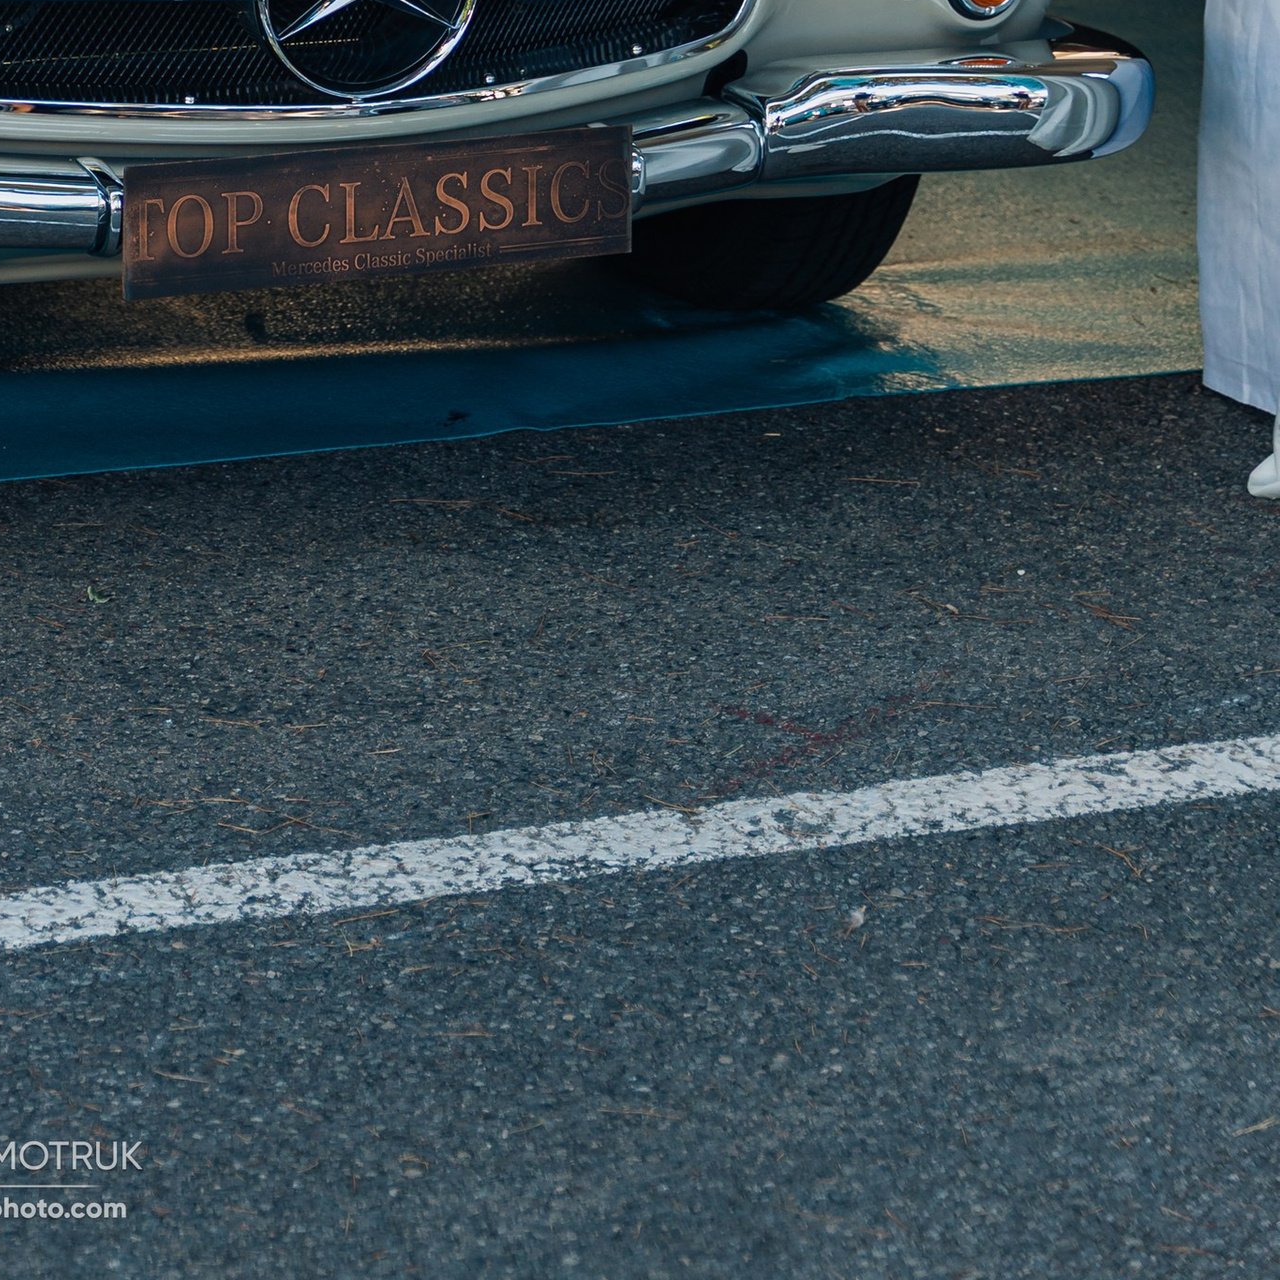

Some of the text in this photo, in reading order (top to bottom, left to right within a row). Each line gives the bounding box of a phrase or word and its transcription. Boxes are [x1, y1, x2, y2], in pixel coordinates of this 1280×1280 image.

[130, 158, 631, 261] TOP CLASSICS
[271, 242, 493, 278] Mercedes Classic Specialist
